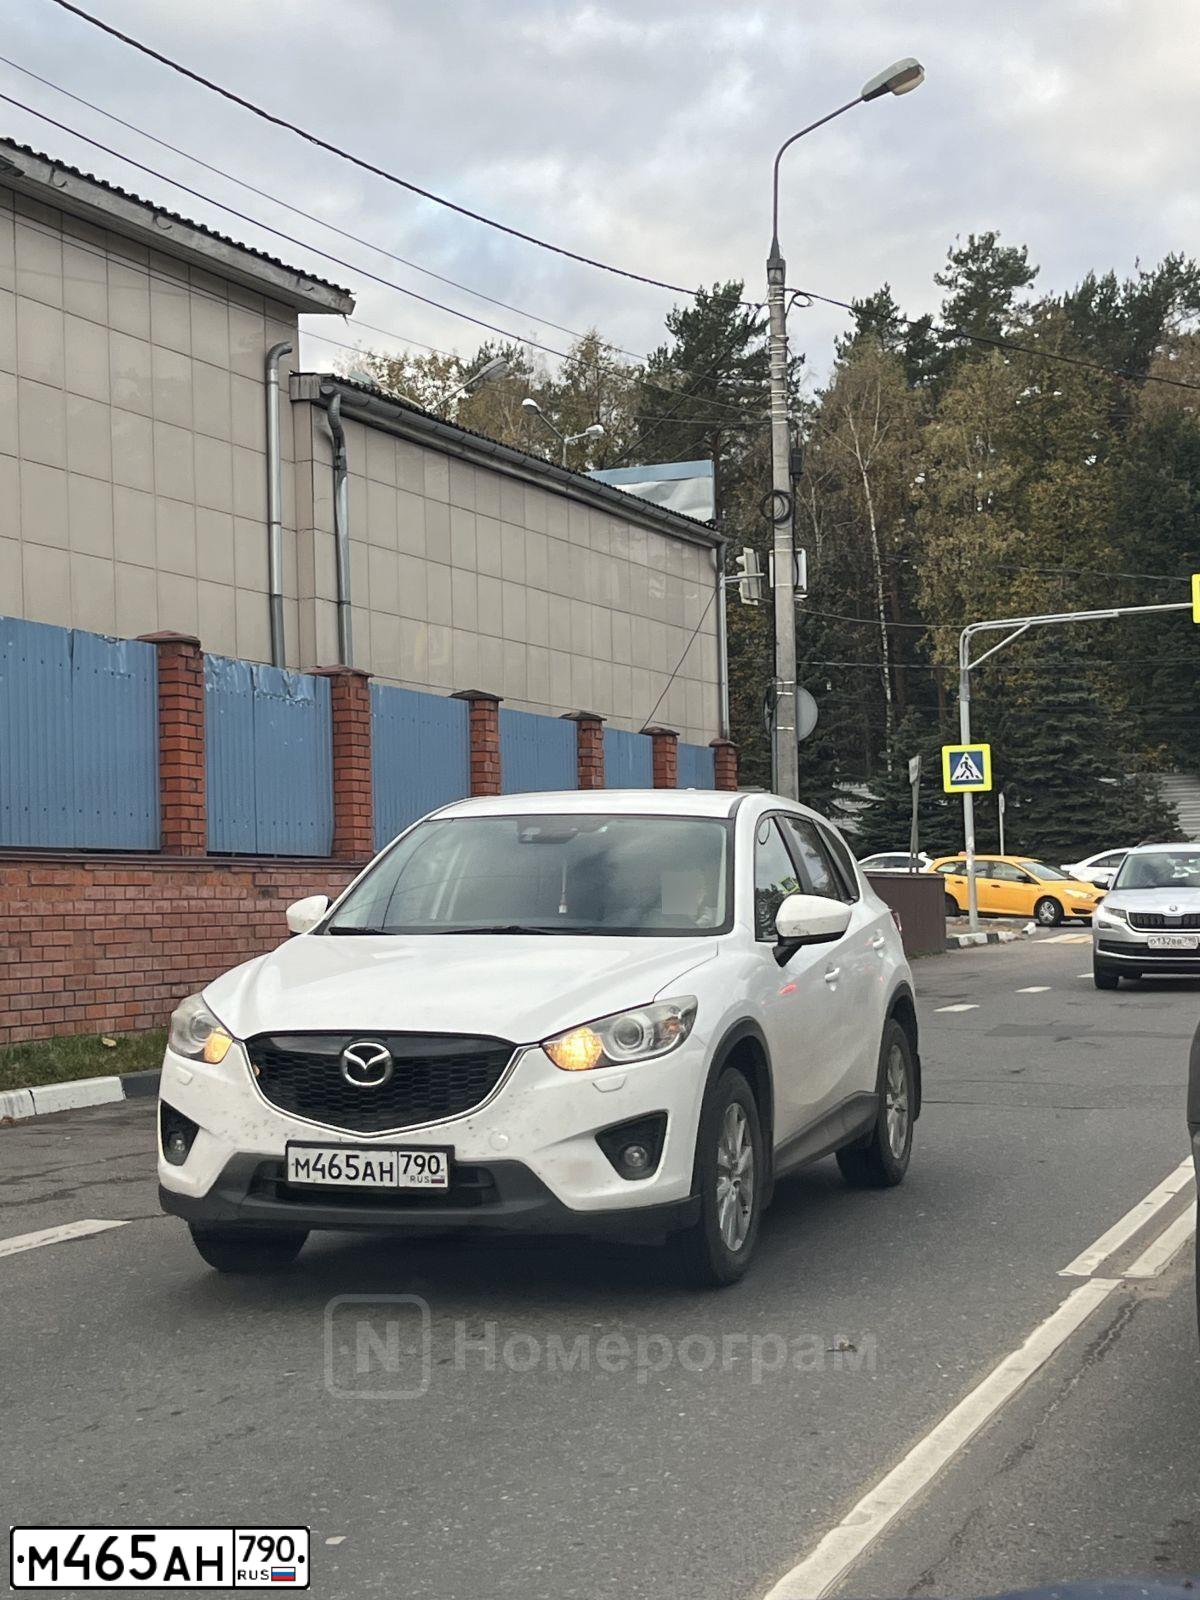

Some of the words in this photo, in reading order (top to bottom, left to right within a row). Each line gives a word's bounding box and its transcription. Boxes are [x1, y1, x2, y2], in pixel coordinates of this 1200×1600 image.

[294, 1152, 394, 1183] М465АН
[400, 1154, 440, 1175] 790
[409, 1175, 430, 1184] RUS
